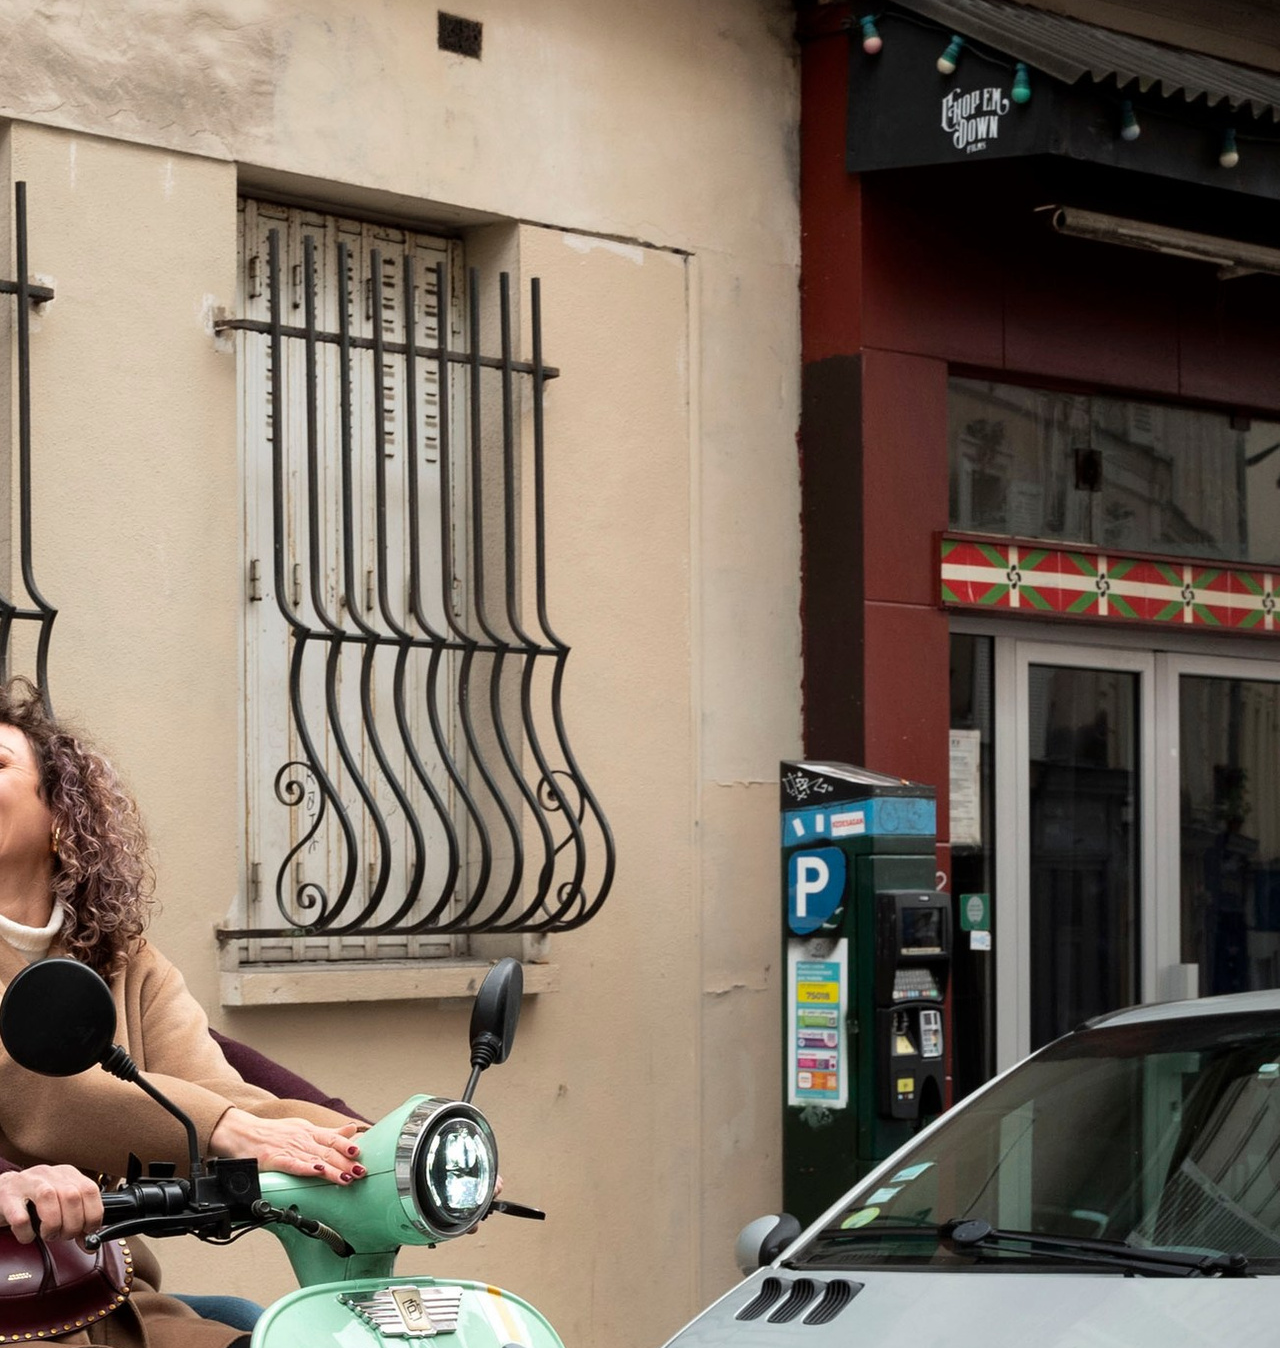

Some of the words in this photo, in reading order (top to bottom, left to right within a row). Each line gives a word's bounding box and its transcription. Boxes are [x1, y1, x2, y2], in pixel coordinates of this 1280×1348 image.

[941, 87, 981, 133] CHOP
[952, 115, 999, 150] DOWN
[796, 856, 830, 917] P
